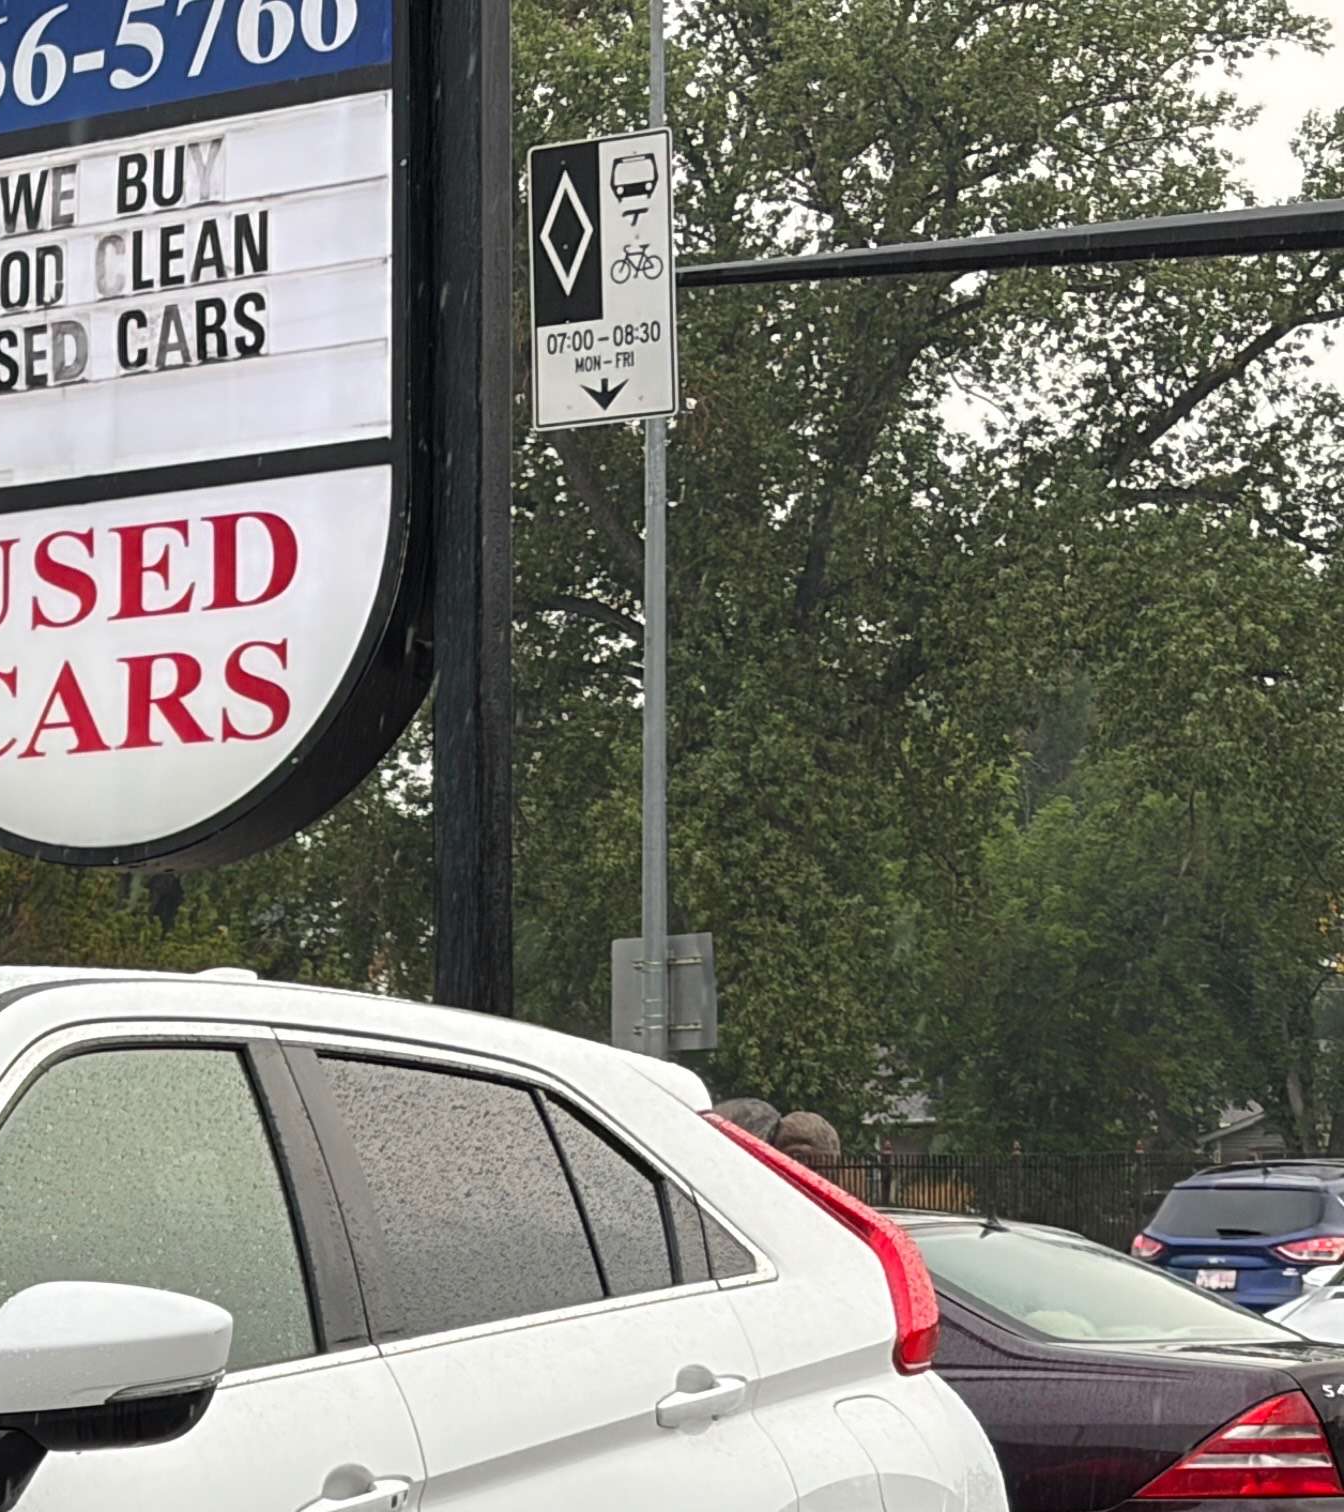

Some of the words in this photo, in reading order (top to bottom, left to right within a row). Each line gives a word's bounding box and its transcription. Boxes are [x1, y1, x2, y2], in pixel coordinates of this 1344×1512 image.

[0, 163, 78, 234] WE
[117, 137, 224, 215] BUY
[95, 210, 269, 297] CLEAN
[118, 292, 267, 371] CARS
[546, 329, 594, 355] 07:00
[613, 320, 661, 347] 08:30
